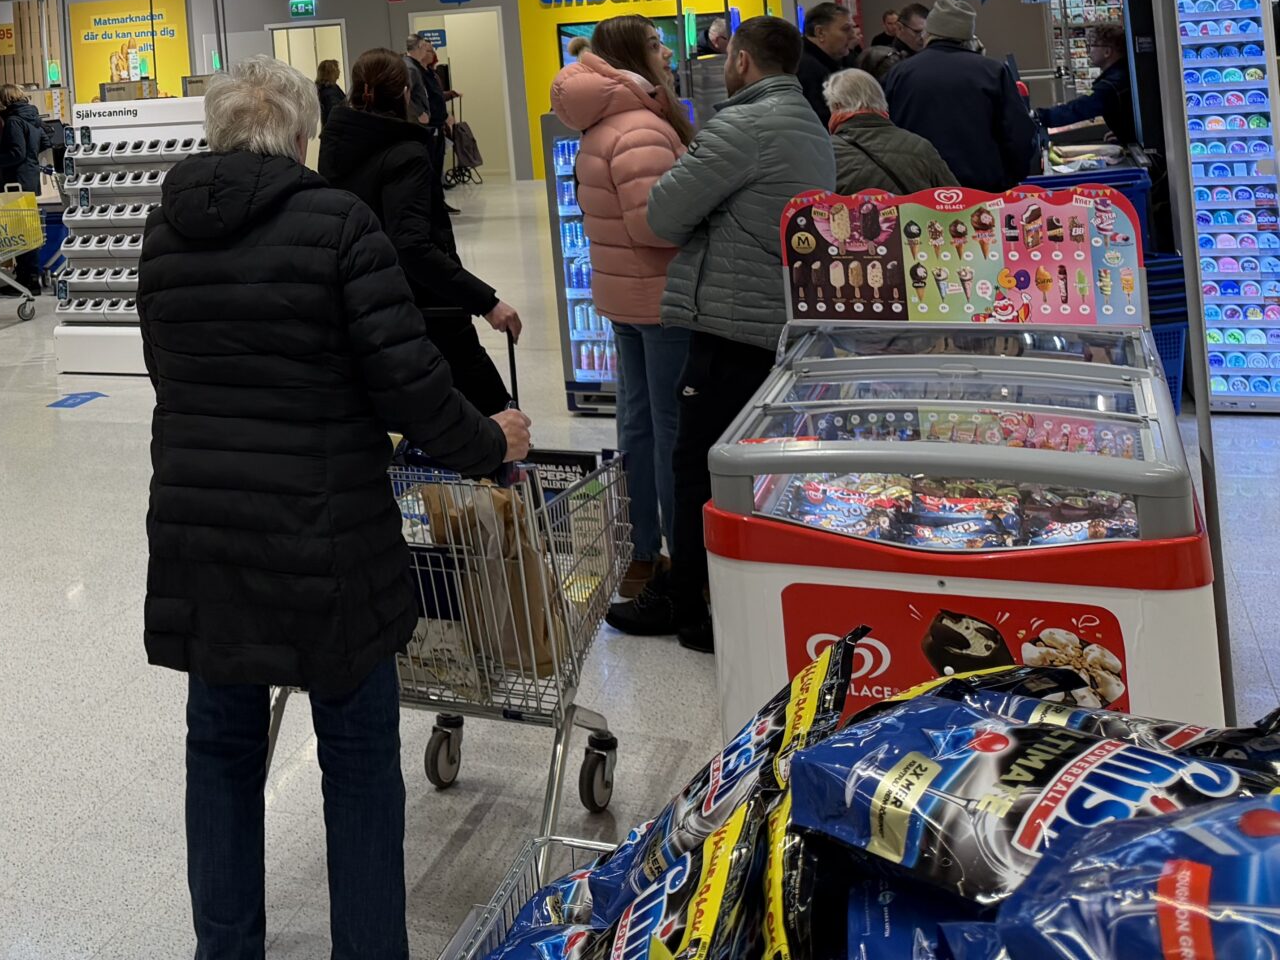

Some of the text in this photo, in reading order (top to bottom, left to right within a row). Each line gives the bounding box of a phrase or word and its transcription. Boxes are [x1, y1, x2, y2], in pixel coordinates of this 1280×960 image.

[93, 12, 164, 27] Matmarknaden
[83, 33, 99, 41] där
[101, 31, 113, 40] du
[115, 29, 131, 39] kan
[160, 27, 175, 38] dig
[75, 107, 138, 119] Självscanning
[848, 685, 891, 700] LACE
[908, 762, 929, 782] 2X
[973, 729, 1086, 818] LTIMATE
[1175, 908, 1190, 932] ON
